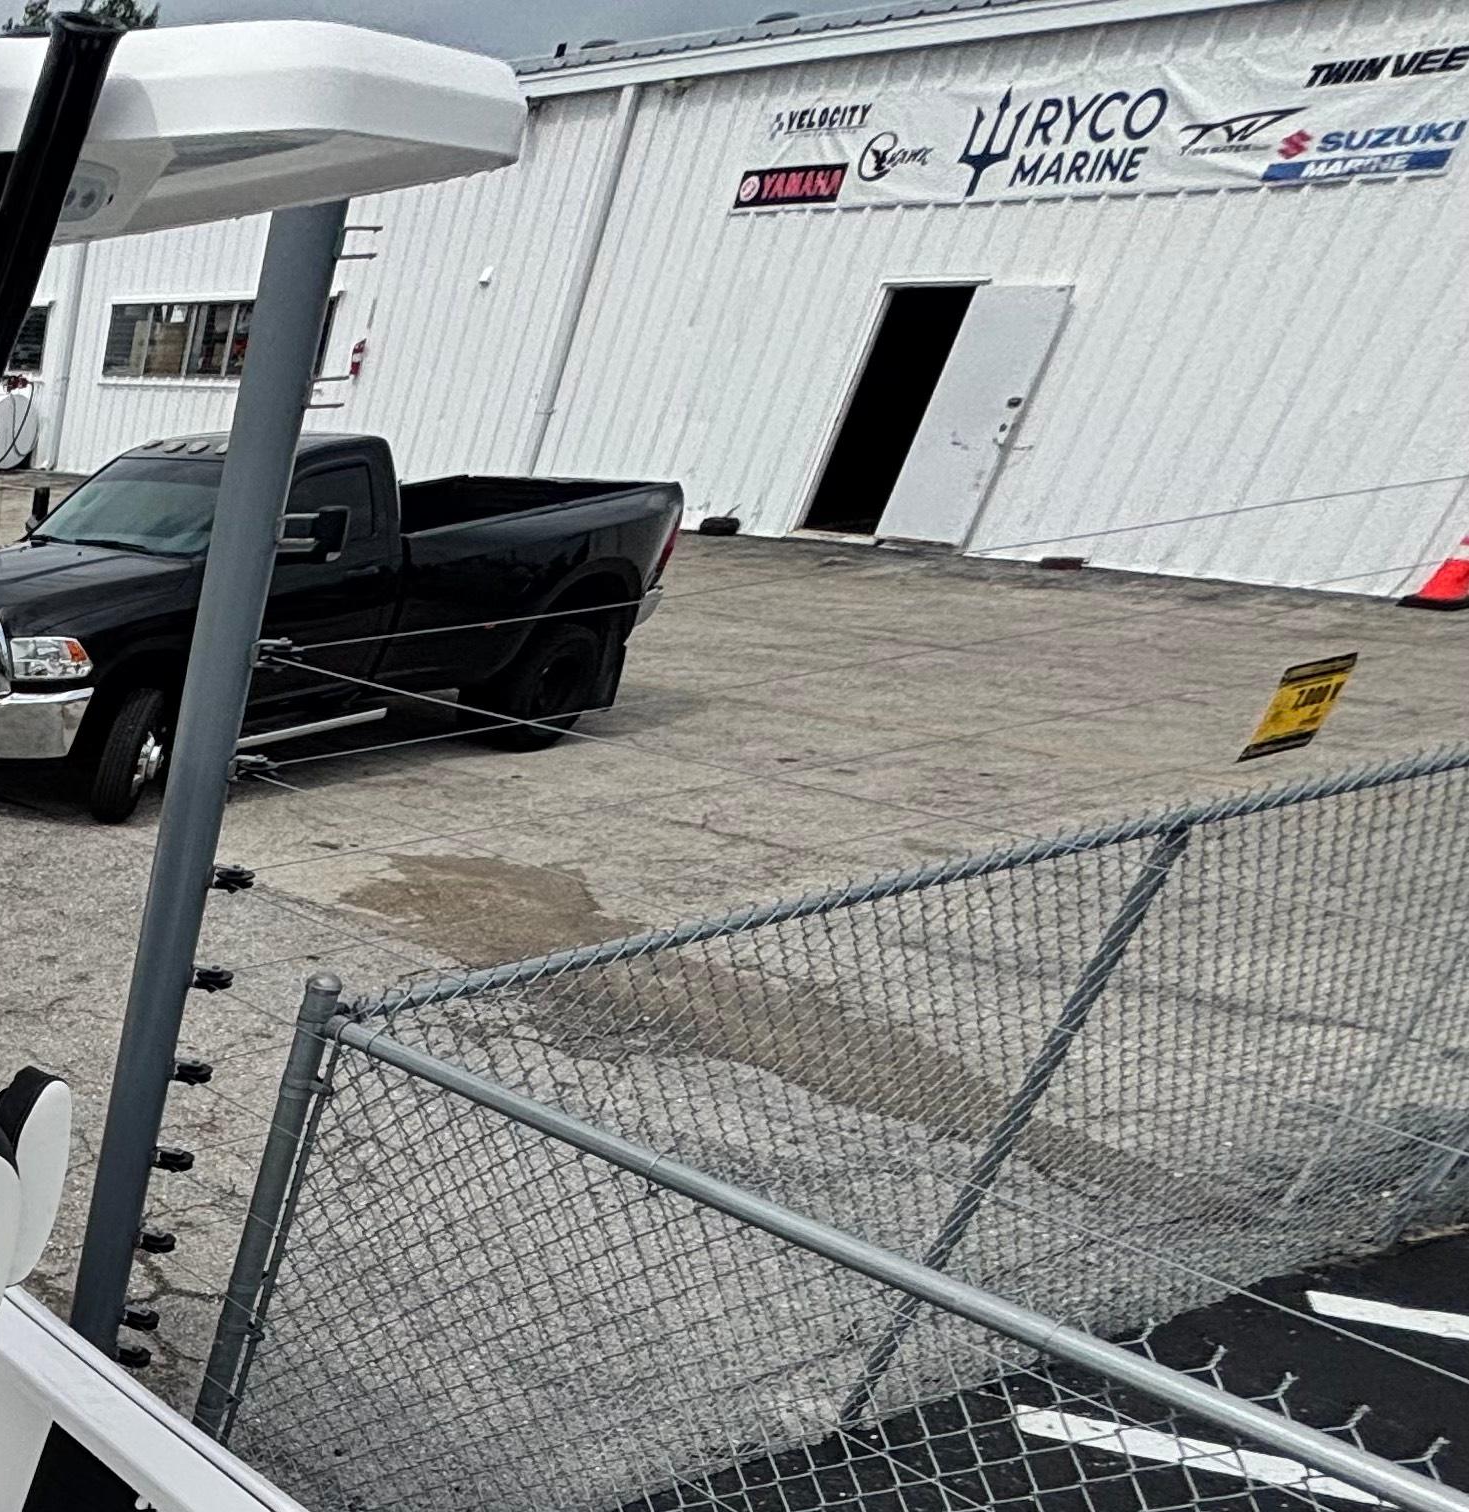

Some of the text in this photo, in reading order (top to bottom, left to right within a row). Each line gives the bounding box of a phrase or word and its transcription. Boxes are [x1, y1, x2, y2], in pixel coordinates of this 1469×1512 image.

[1305, 45, 1469, 88] TWIN VEE
[787, 103, 872, 131] VELOCITY
[1025, 87, 1169, 148] RYCO
[1317, 119, 1468, 152] SUZUKI
[1008, 147, 1150, 188] MARINE
[1300, 153, 1410, 178] MARINE
[760, 169, 843, 200] YAMAHA
